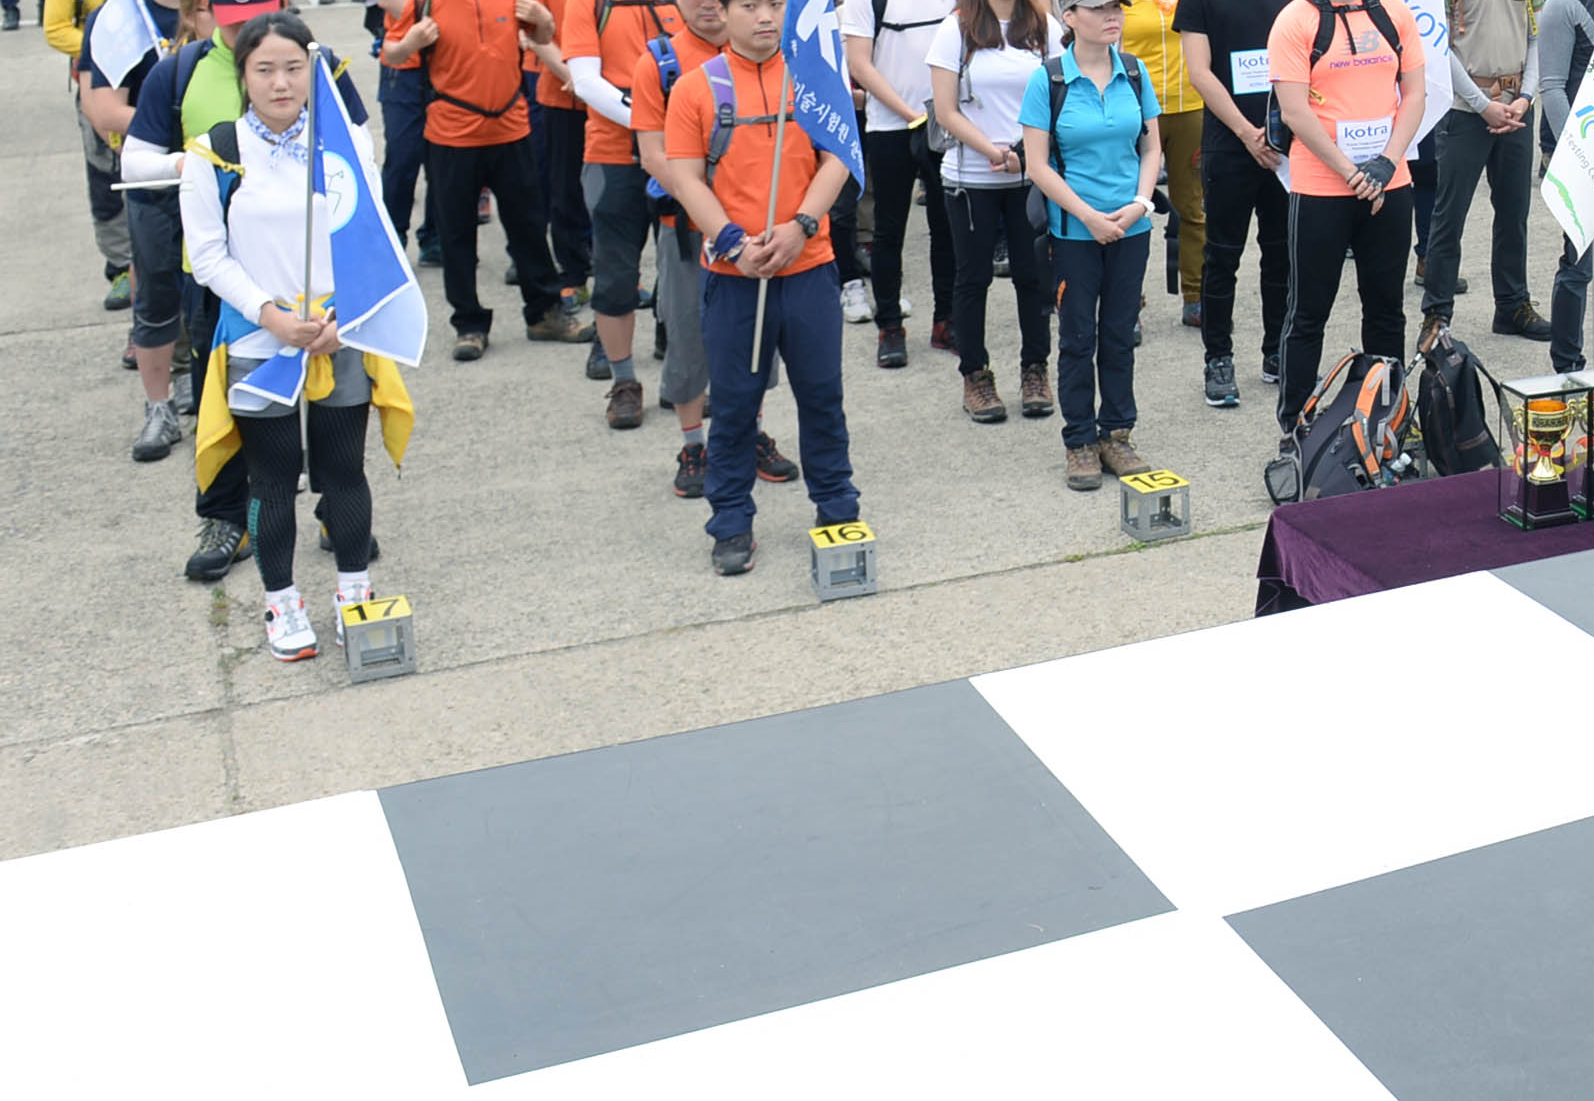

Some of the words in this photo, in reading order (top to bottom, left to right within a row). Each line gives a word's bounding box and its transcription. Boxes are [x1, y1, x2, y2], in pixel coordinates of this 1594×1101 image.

[793, 76, 850, 144] 기술시험원
[1344, 124, 1388, 141] kotra
[1129, 471, 1181, 490] 15
[815, 524, 868, 545] 16
[346, 598, 400, 621] 17
